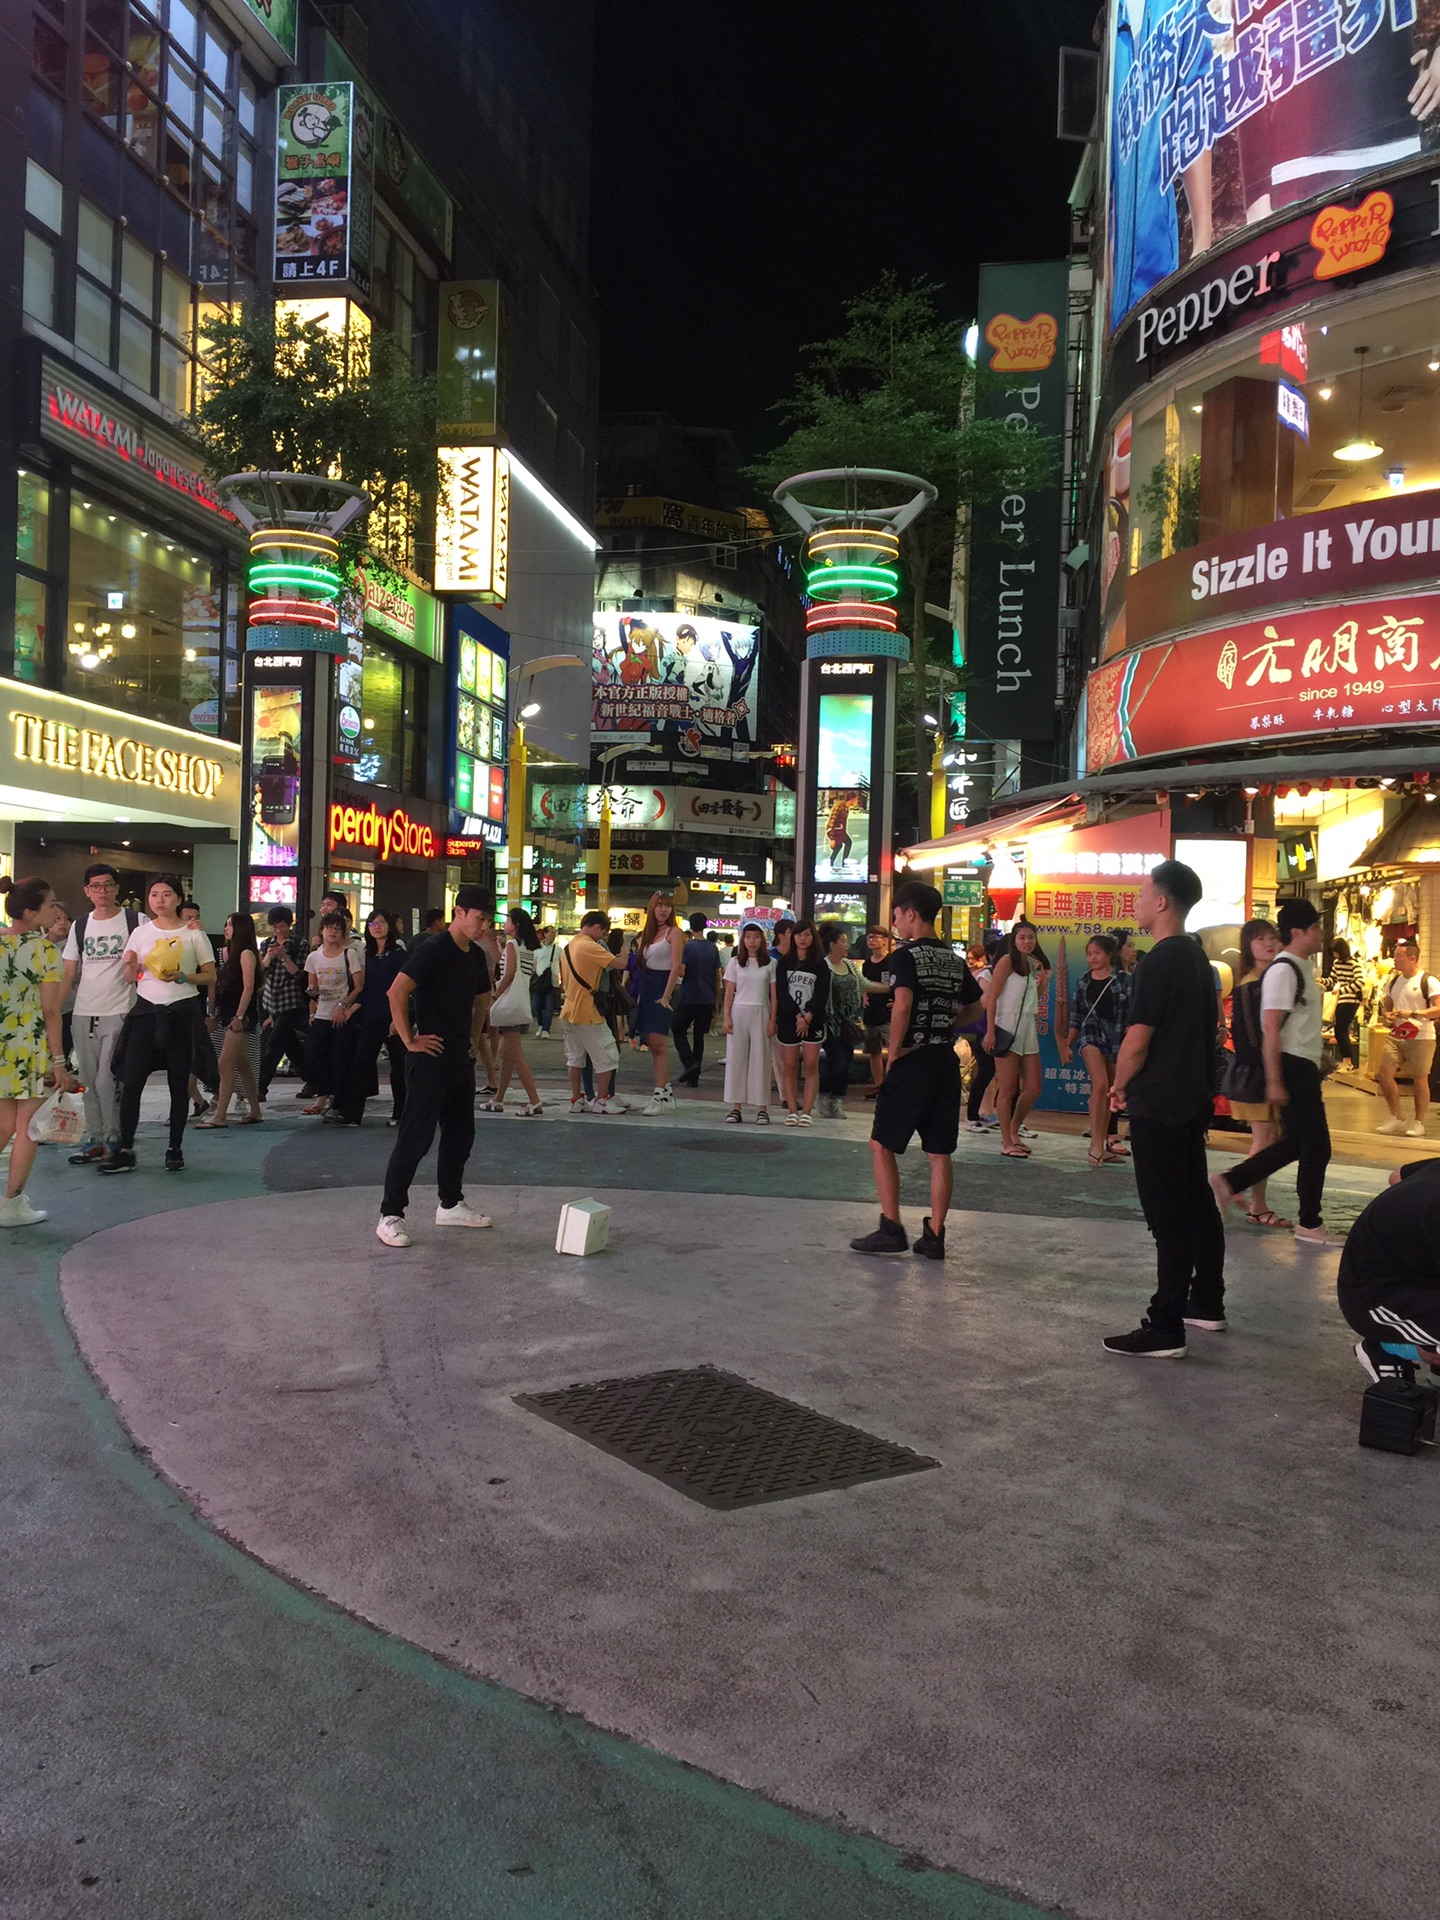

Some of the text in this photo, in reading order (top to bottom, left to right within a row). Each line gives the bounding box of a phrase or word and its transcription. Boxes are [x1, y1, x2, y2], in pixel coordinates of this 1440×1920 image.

[1136, 250, 1281, 363] Pepper
[55, 386, 138, 456] WATAMI
[143, 440, 196, 491] Japanese
[458, 456, 481, 581] WATAMI
[996, 382, 1041, 693] Peer Lunch
[1190, 542, 1289, 601] Sizzle
[1302, 528, 1333, 574] It
[254, 656, 303, 668] 台北西門町
[1241, 615, 1440, 687] 元明商
[820, 662, 875, 675] 台北西門町
[1299, 679, 1385, 702] since 1949
[1250, 713, 1286, 731] 鳳梨酥
[1312, 704, 1355, 722] 牛軋糖
[13, 713, 224, 799] THE FACE SHOP
[446, 838, 482, 850] Superdry
[946, 883, 979, 894] 漢中街
[1033, 890, 1140, 919] 巨無霸霜淇
[624, 918, 640, 926] ERA
[84, 934, 124, 957] 852
[795, 989, 803, 1006] 8
[1045, 1067, 1092, 1080] 超高冰
